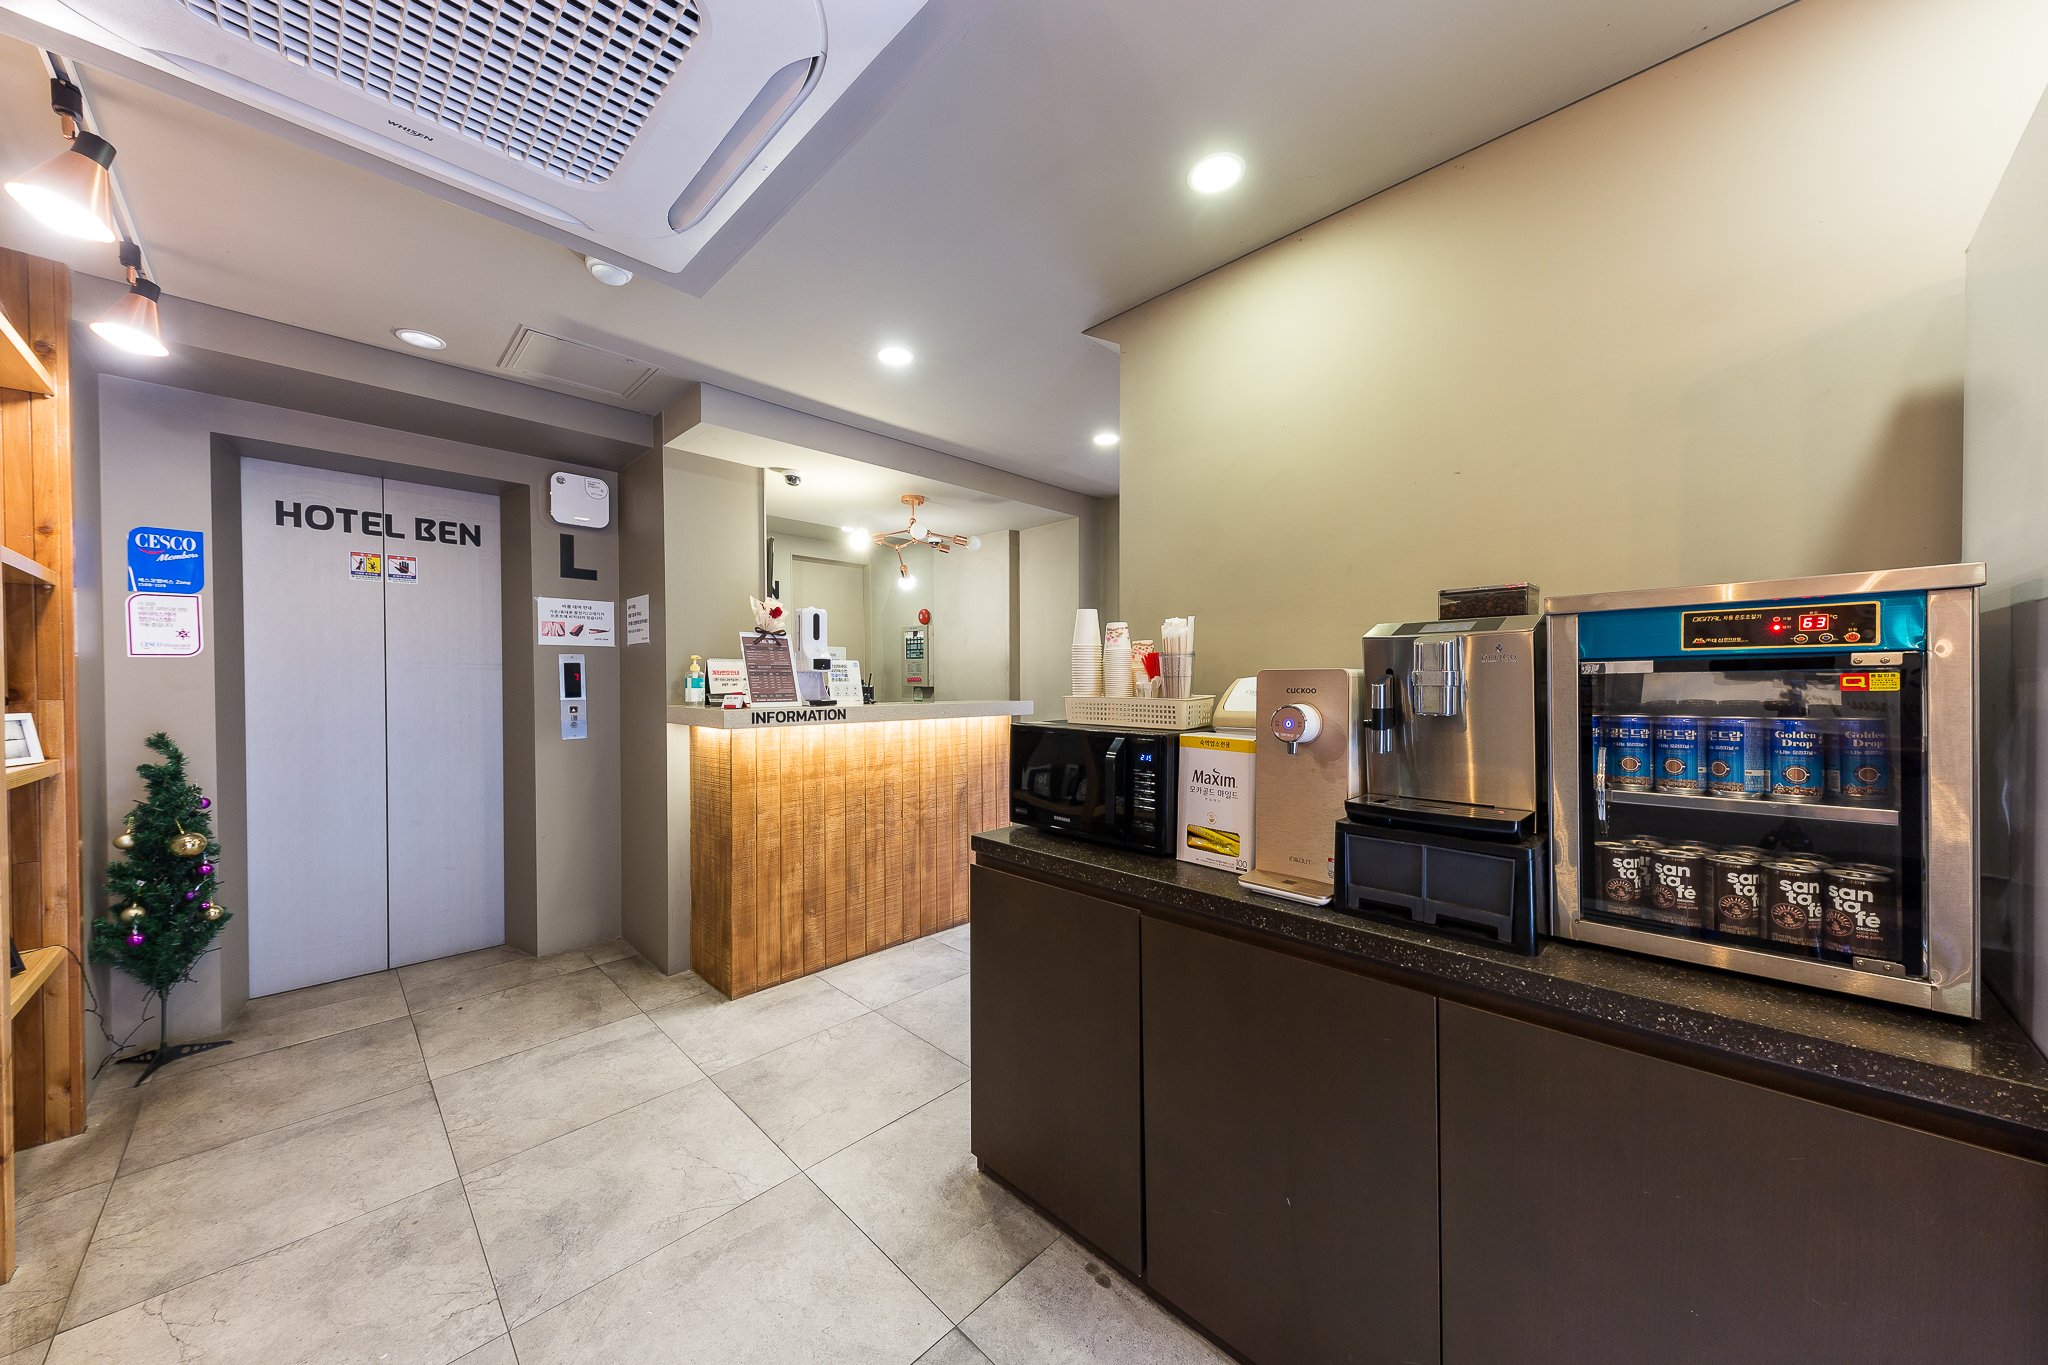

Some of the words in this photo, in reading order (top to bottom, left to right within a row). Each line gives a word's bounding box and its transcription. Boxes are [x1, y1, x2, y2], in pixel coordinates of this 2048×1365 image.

[387, 119, 434, 142] WHISEN
[275, 499, 405, 540] HOTEL
[414, 516, 482, 548] BEN
[134, 532, 197, 552] CESCO
[155, 550, 199, 562] Members
[559, 532, 598, 582] L
[1802, 616, 1827, 628] 63
[751, 708, 847, 725] INFORMATION
[1610, 727, 1650, 739] 골든드랍
[1774, 730, 1817, 739] Golden
[1844, 730, 1886, 739] Golden
[1200, 739, 1231, 749] 숙박업소전용
[1781, 739, 1813, 749] Drop
[1852, 739, 1883, 749] Drop
[1191, 768, 1236, 788] Maxim
[1189, 785, 1215, 797] 모카골드
[1217, 789, 1239, 800] 마일드
[1618, 867, 1637, 879] ta
[1654, 862, 1691, 877] san
[1658, 872, 1681, 887] ta
[1779, 879, 1820, 894] san
[1675, 884, 1697, 899] fé
[1733, 882, 1756, 897] ta
[1828, 885, 1874, 903] san
[1785, 890, 1813, 906] ta
[1833, 896, 1861, 914] ta
[1855, 911, 1881, 928] fé
